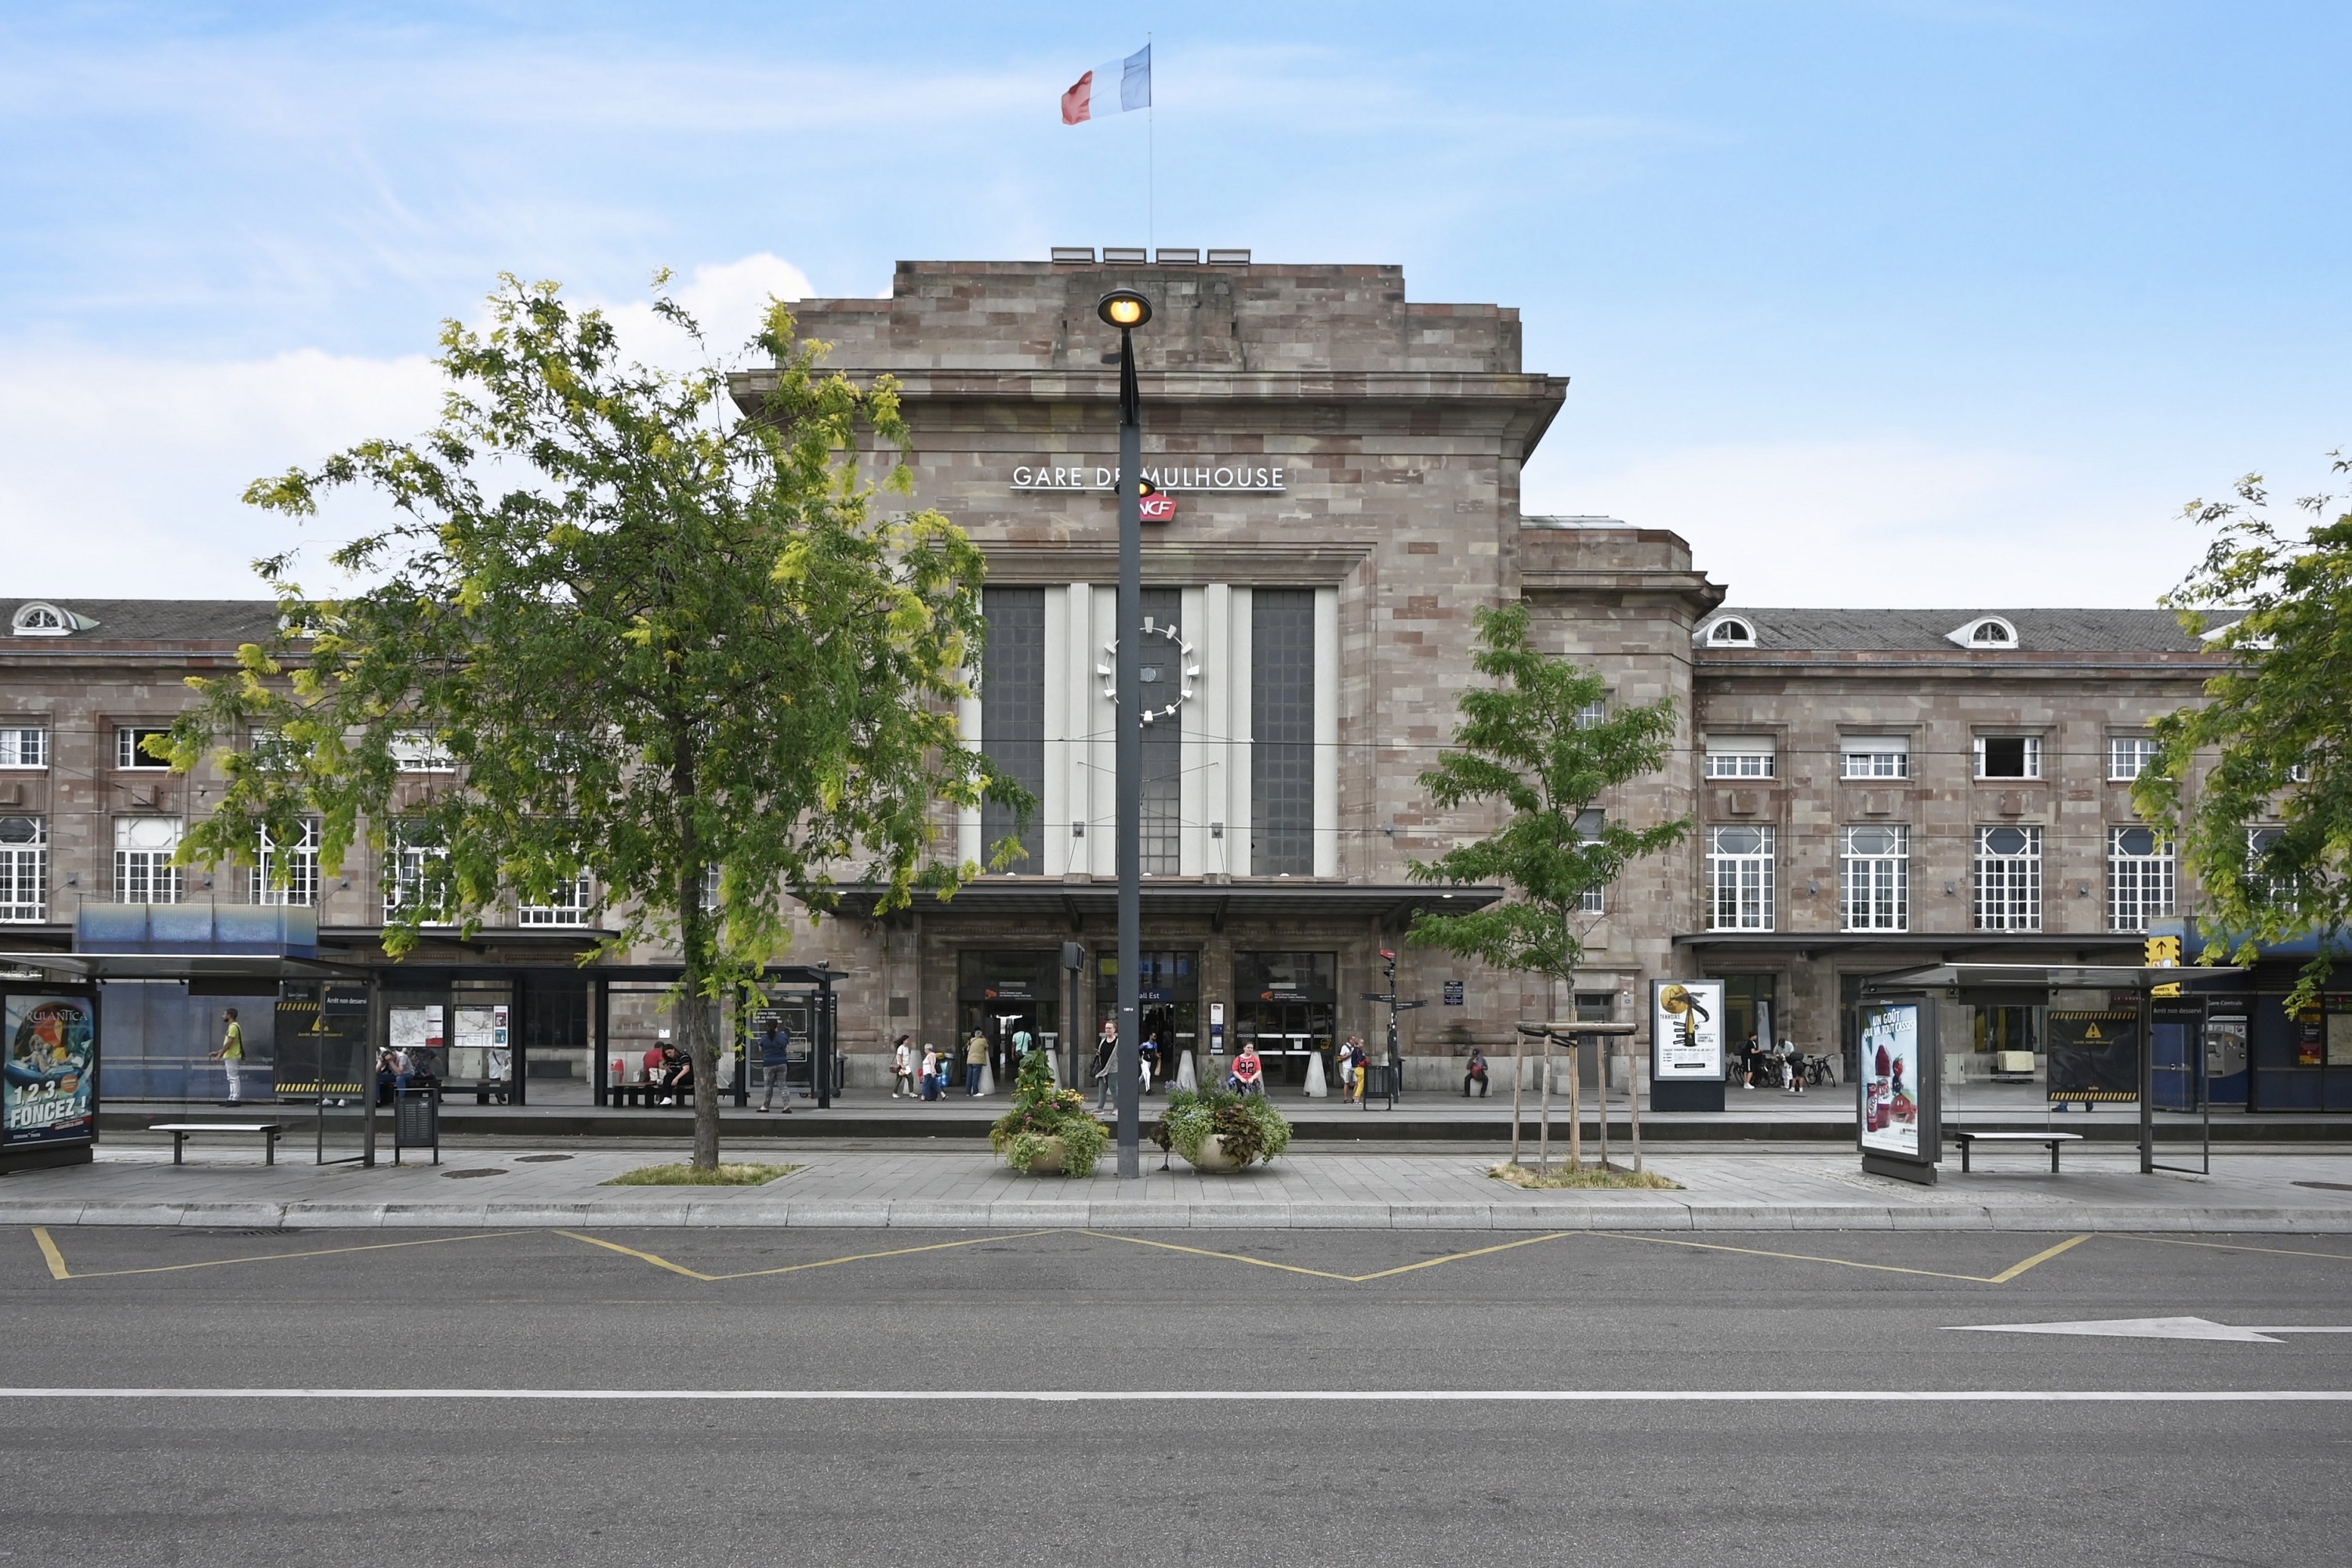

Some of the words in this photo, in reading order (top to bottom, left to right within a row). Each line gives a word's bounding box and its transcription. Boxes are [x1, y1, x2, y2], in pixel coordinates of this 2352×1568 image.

[1013, 466, 1082, 486] GARE
[1140, 467, 1283, 487] MULHOUSE
[1140, 501, 1173, 515] NCF
[27, 1009, 88, 1023] RULANTICA
[1872, 1014, 1882, 1026] UN
[1883, 1008, 1900, 1024] GOÛT
[1864, 1028, 1873, 1038] QUI
[1873, 1025, 1881, 1036] VA
[1882, 1023, 1895, 1035] TOUT
[1240, 1062, 1254, 1073] 92
[10, 1098, 75, 1129] FONCEZ
[80, 1095, 86, 1114] !
